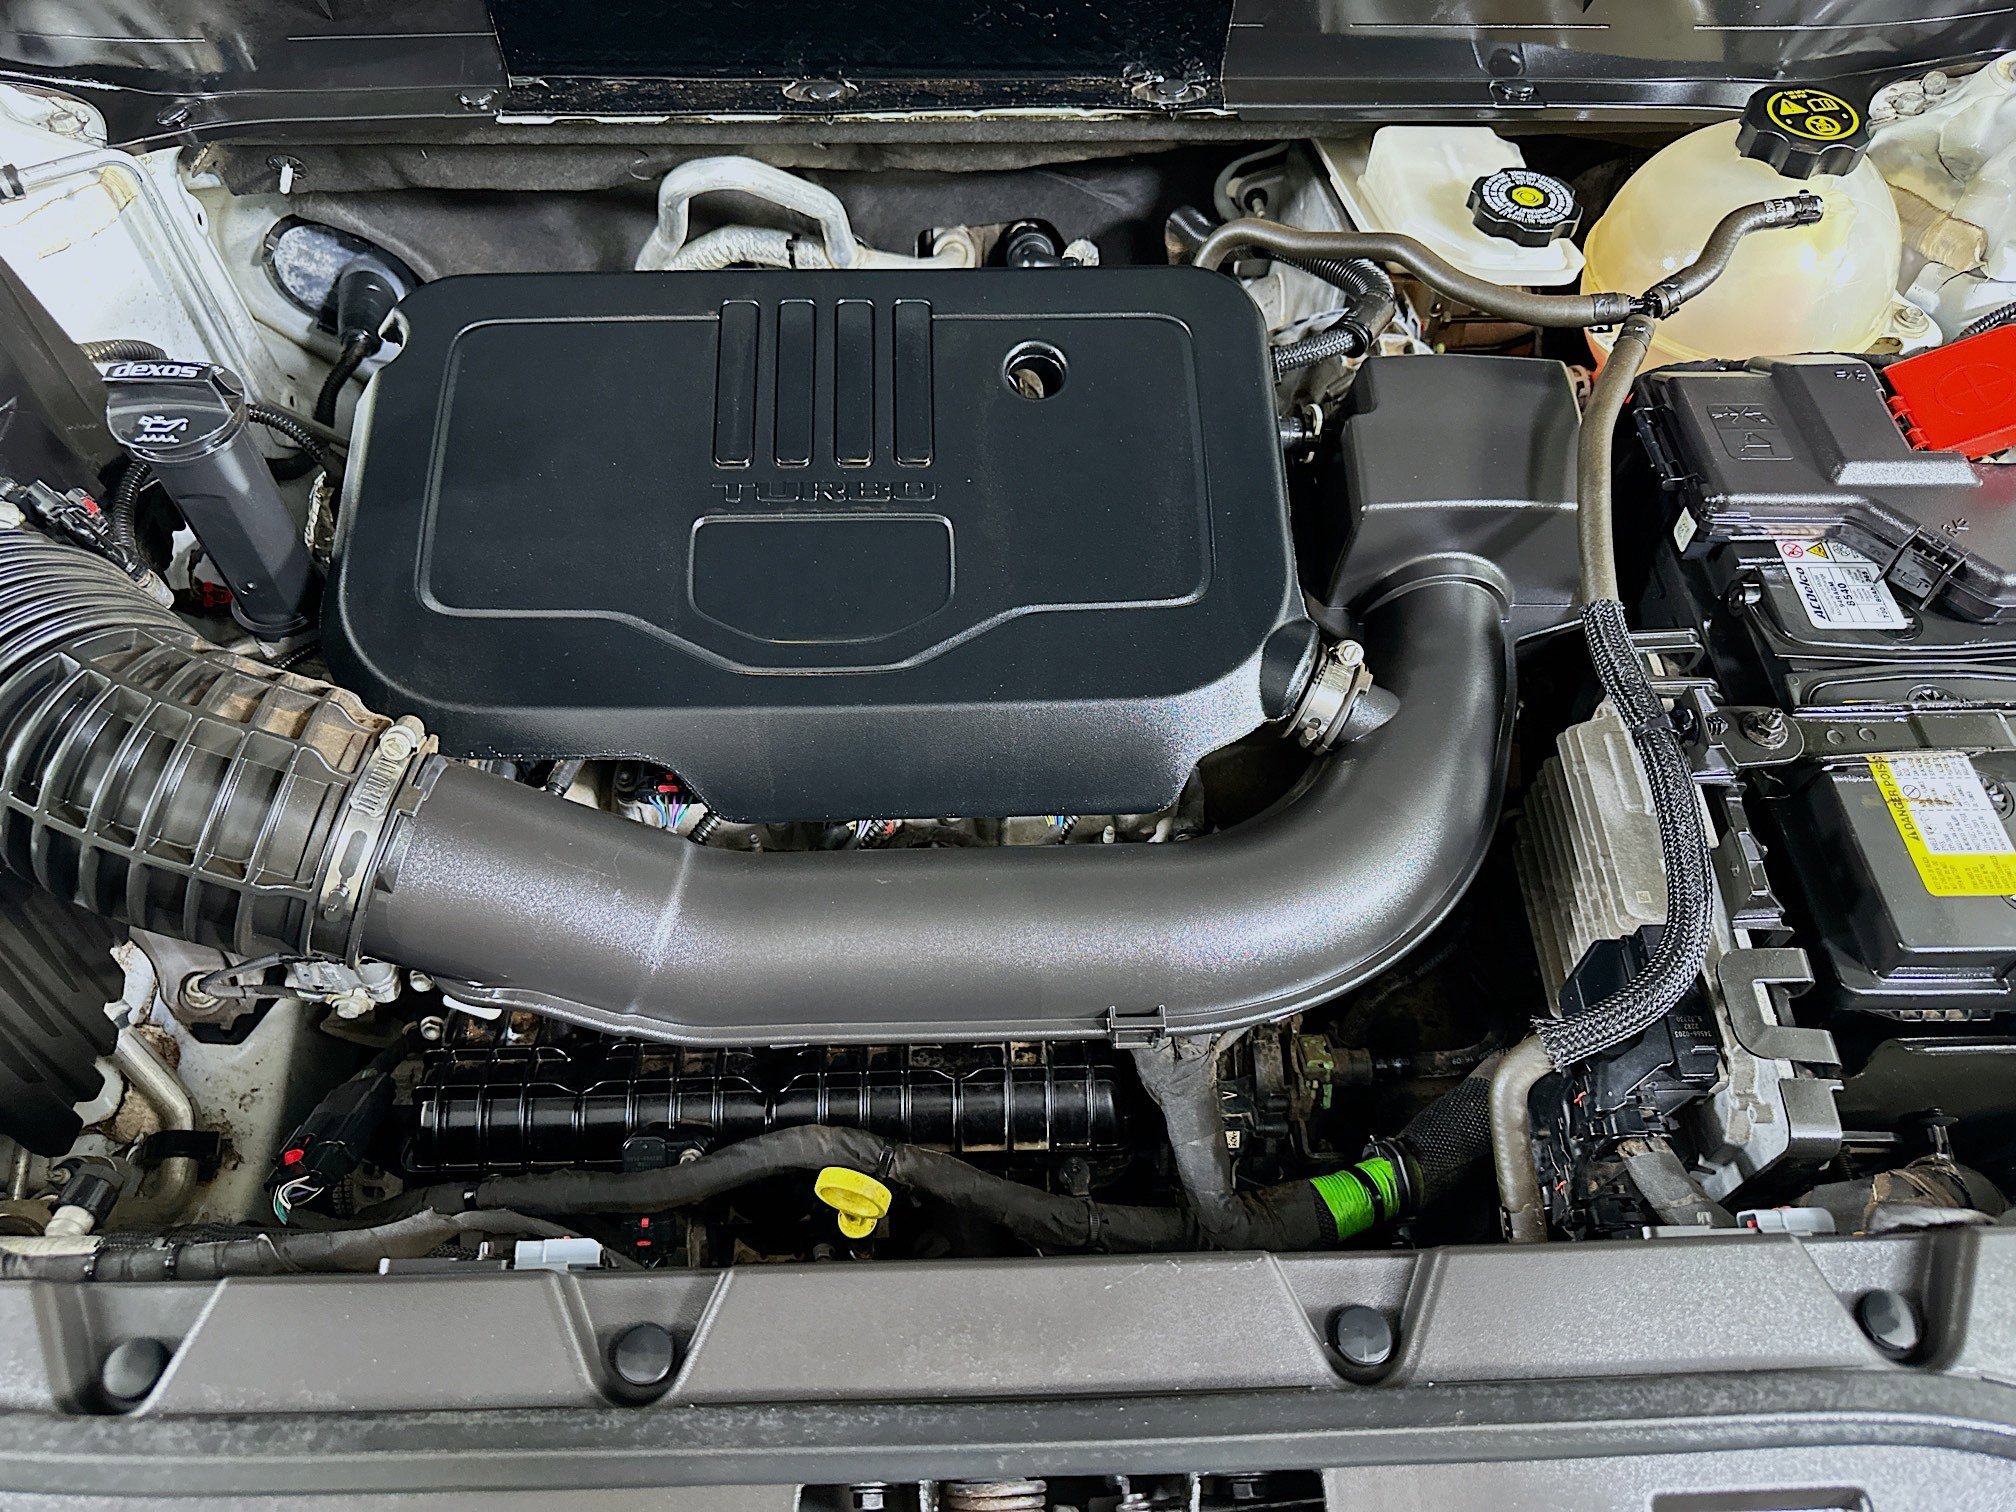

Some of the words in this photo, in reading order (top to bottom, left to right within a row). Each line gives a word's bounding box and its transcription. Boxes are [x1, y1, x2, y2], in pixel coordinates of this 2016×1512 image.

[112, 361, 202, 379] dexos
[711, 481, 938, 504] TURBO
[1795, 566, 1826, 620] ACDelco
[1837, 582, 1856, 607] 8540
[1875, 762, 1915, 830] DANGER/POIS
